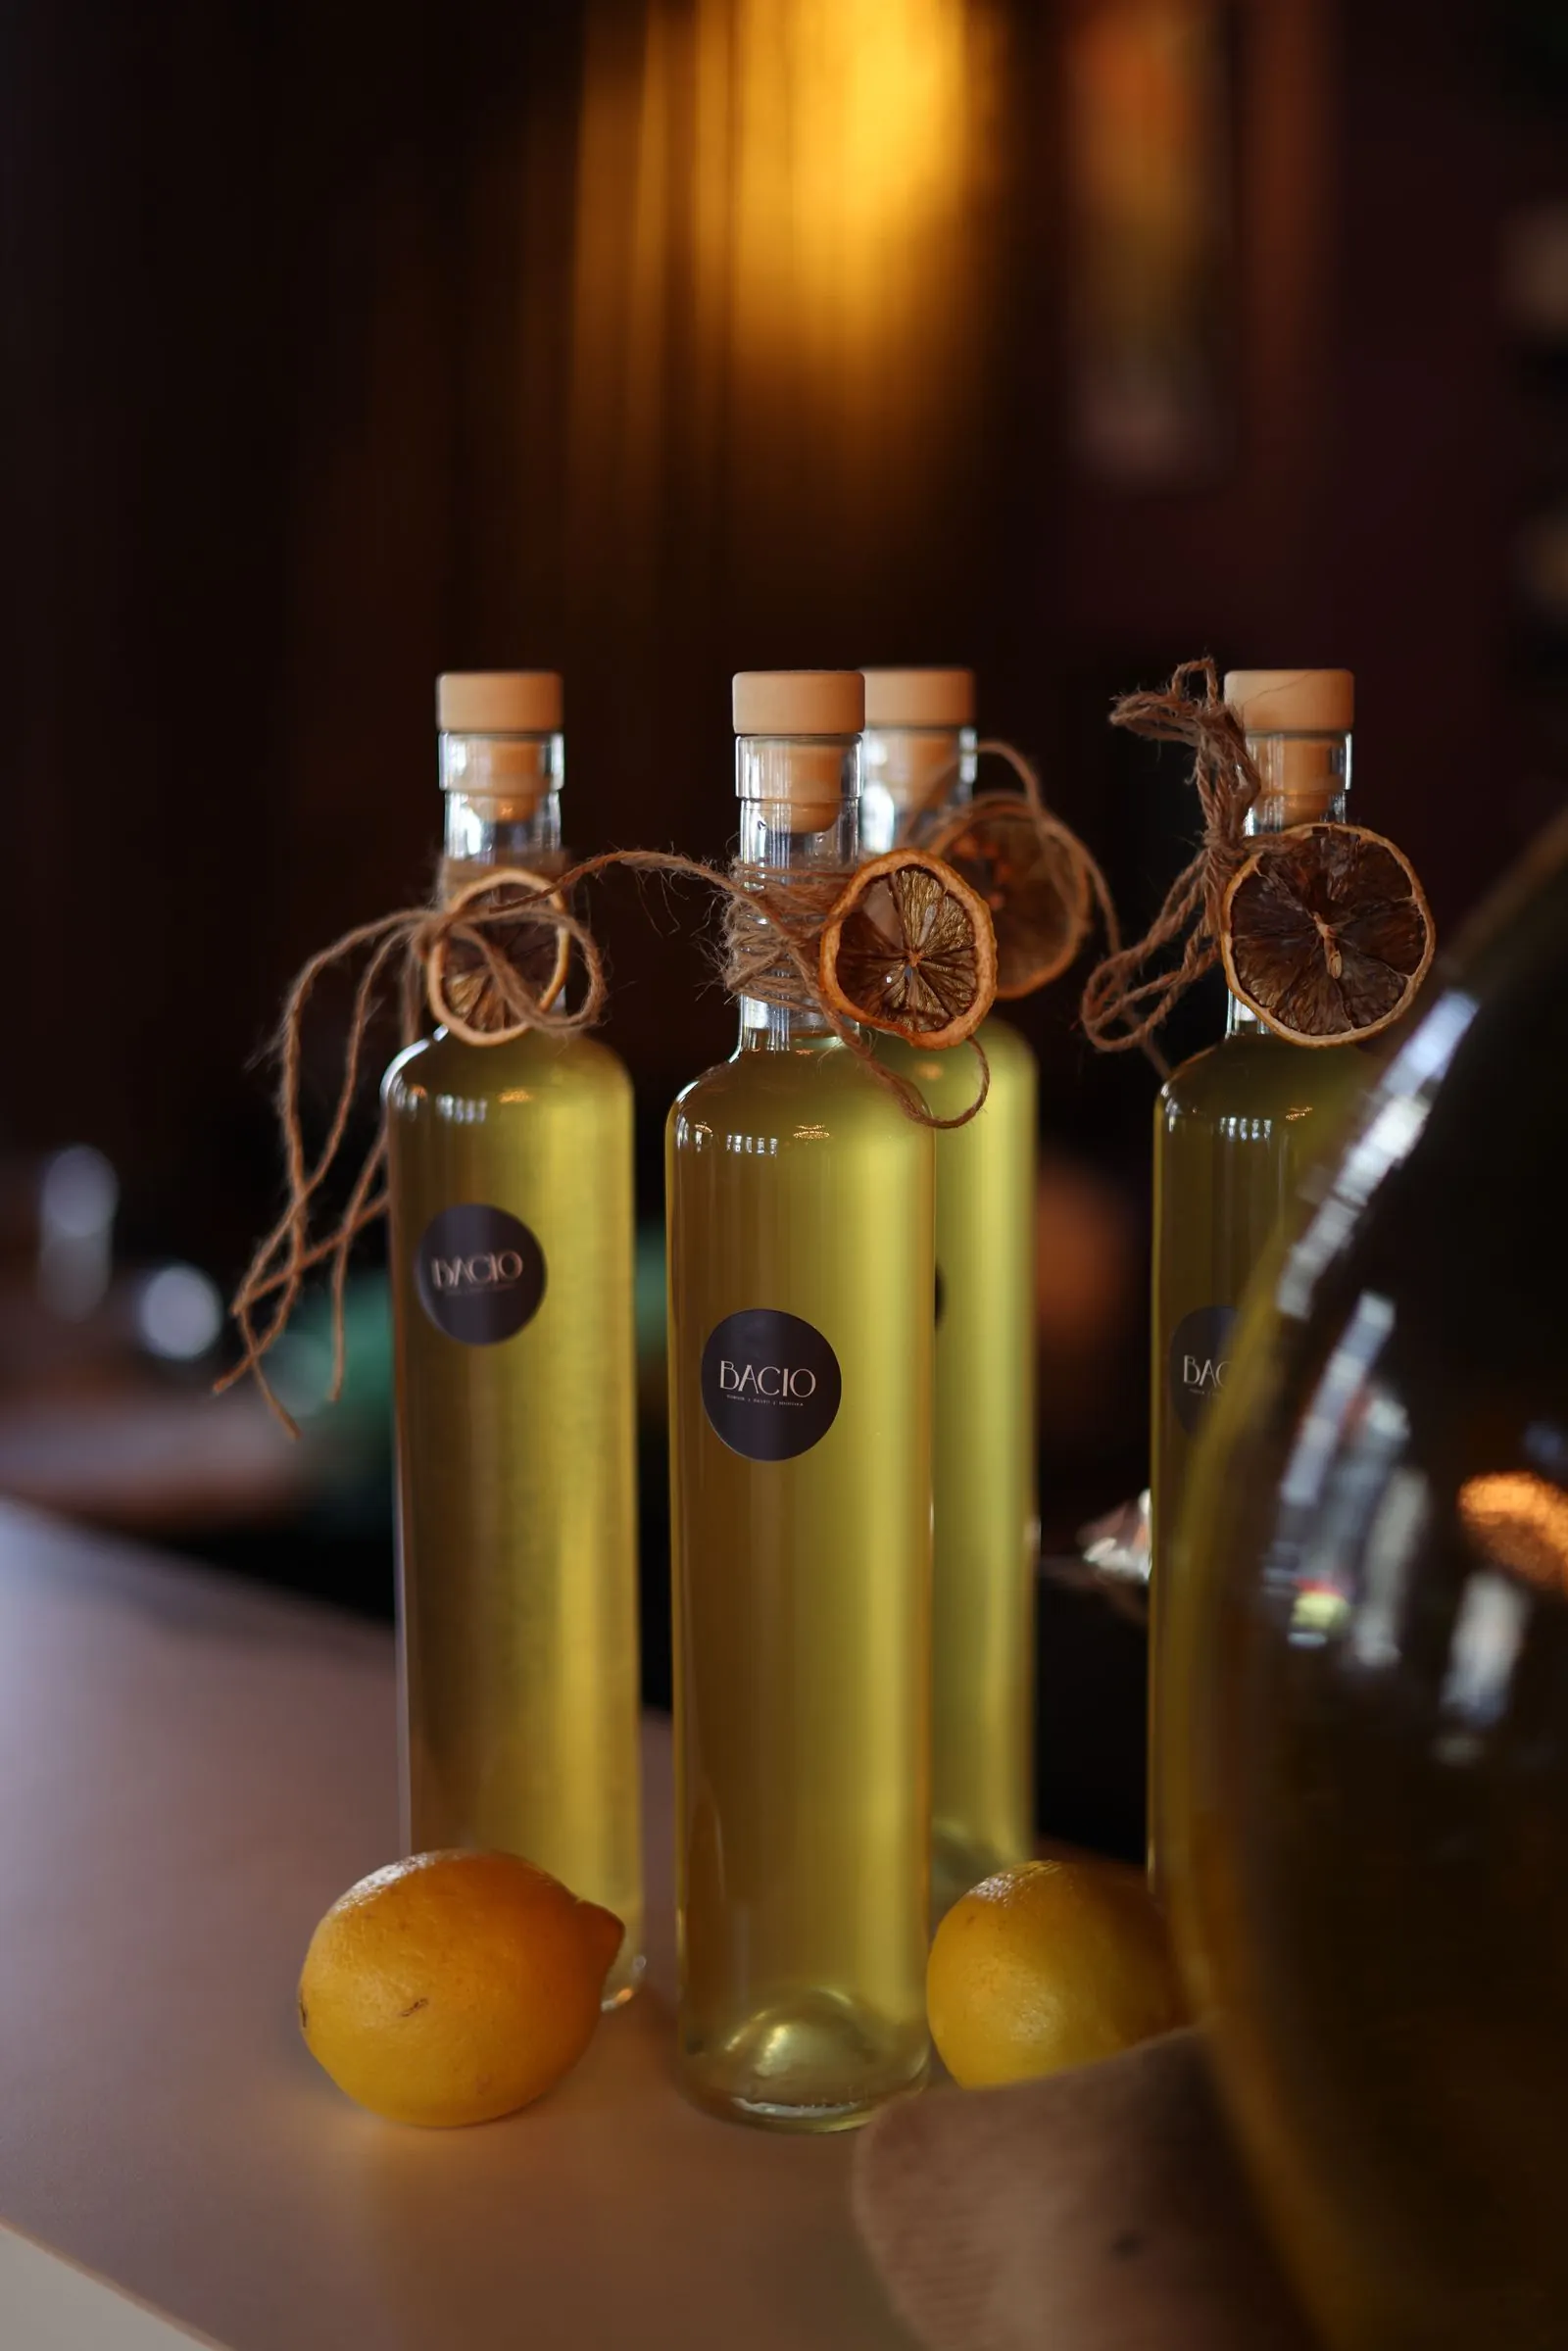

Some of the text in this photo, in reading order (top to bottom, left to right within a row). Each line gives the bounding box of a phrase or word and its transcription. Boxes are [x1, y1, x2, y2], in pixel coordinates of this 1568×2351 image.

[431, 1251, 523, 1289] BACIO
[720, 1360, 815, 1397] BACIO
[1183, 1354, 1232, 1388] BAC
